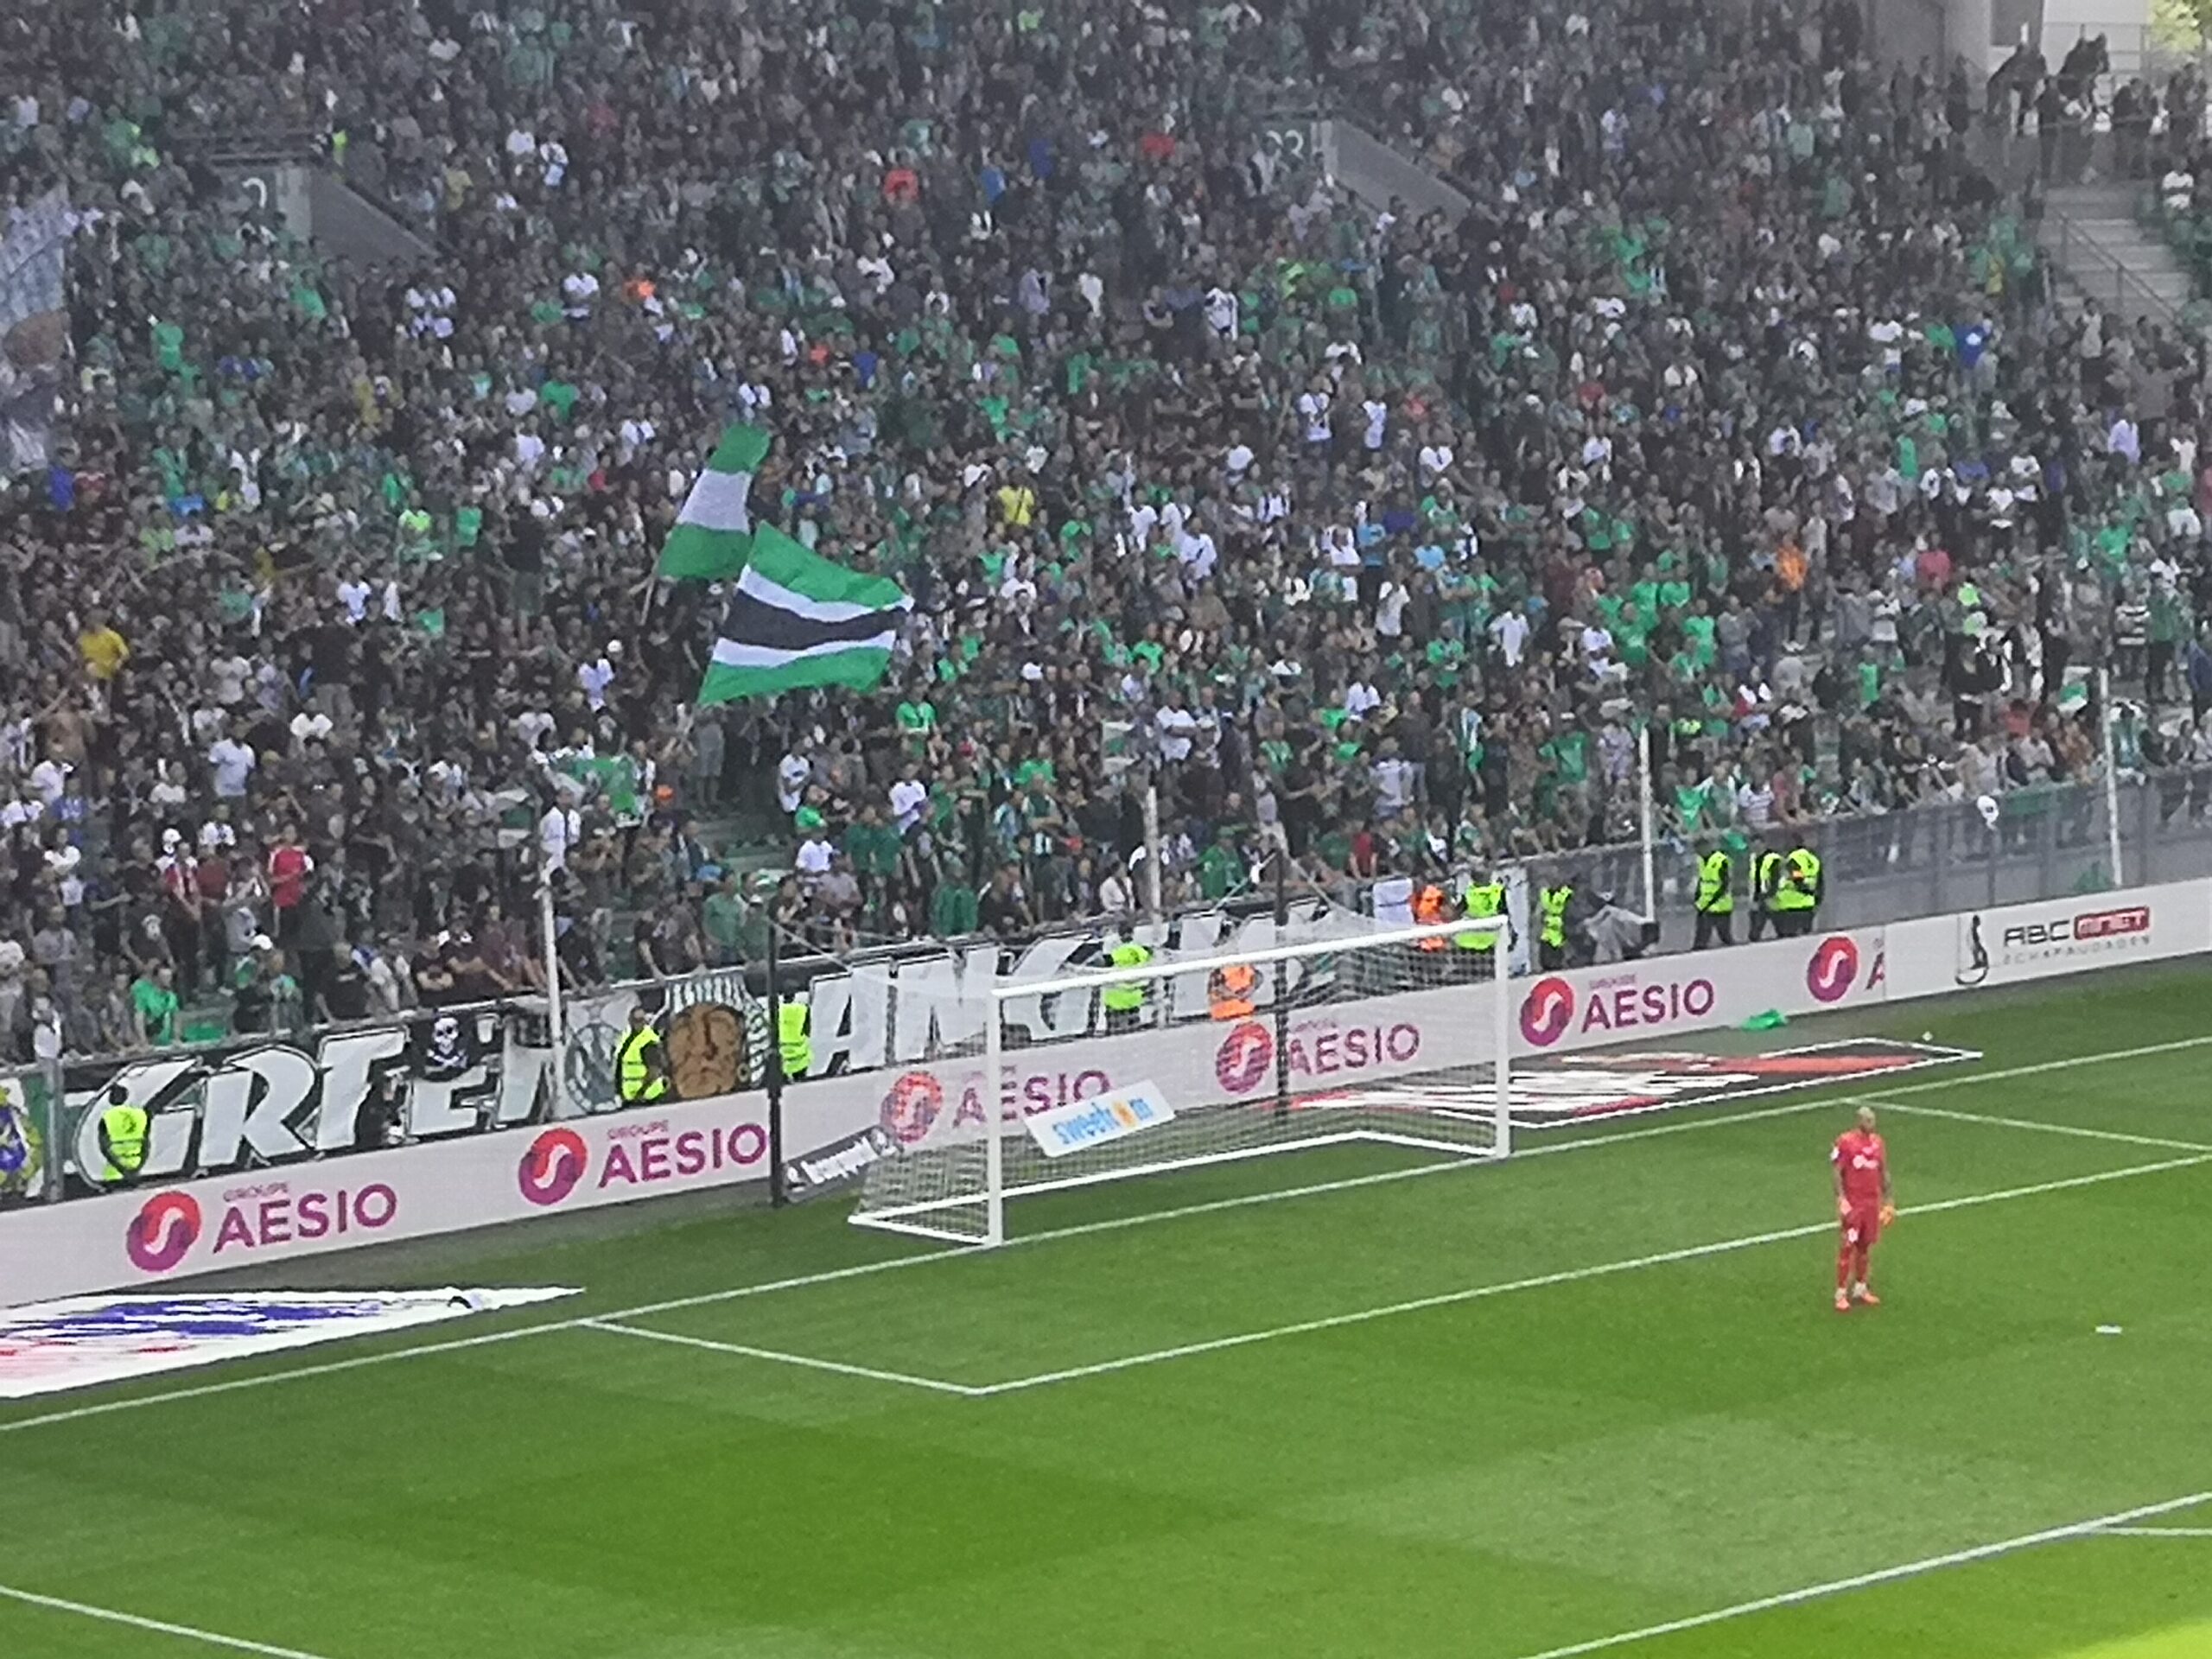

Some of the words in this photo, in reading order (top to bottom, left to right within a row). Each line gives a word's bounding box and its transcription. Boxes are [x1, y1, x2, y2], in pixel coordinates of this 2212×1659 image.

[2005, 920, 2070, 946] ABC
[1582, 979, 1715, 1033] AESIO
[597, 1123, 767, 1188] AESIO
[213, 1183, 397, 1254] AESIO
